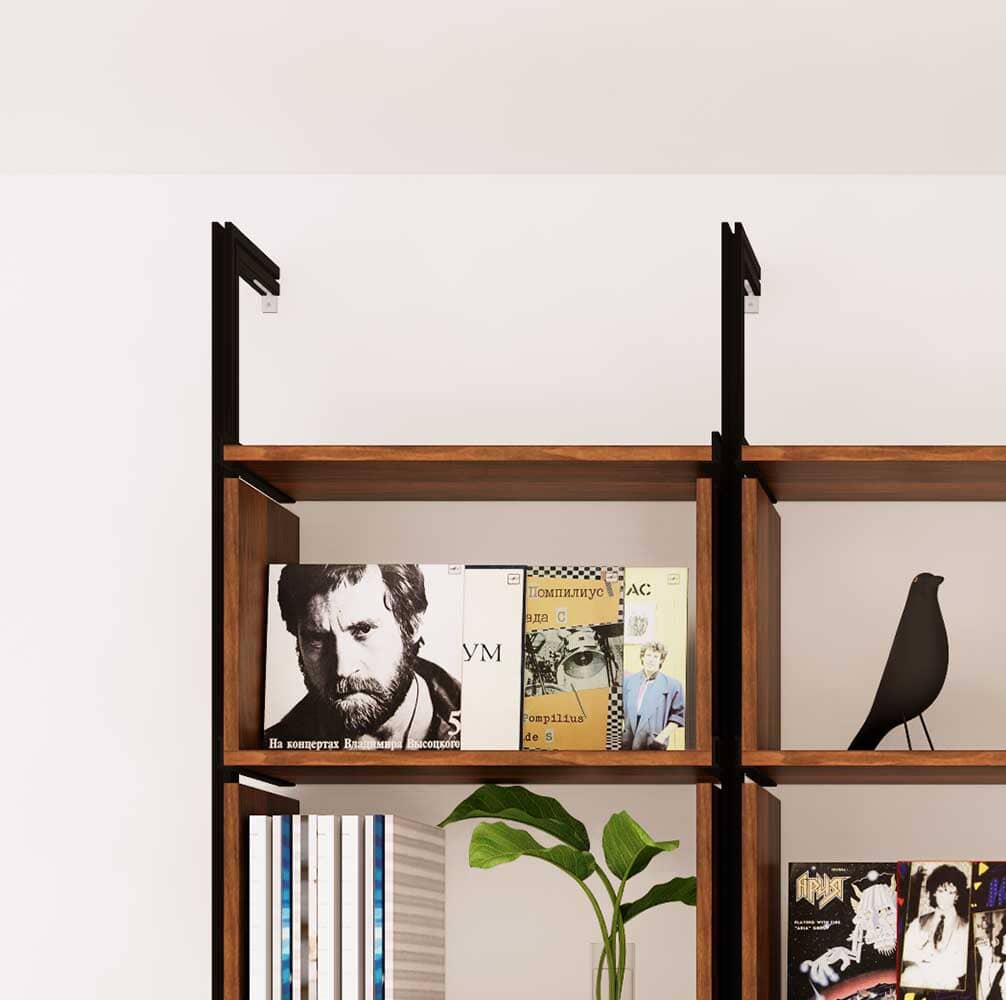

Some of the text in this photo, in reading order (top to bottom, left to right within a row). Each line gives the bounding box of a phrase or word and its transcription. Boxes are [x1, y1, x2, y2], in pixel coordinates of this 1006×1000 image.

[529, 586, 604, 600] Помпилиус
[626, 583, 651, 596] АС
[463, 643, 501, 662] УМ
[449, 711, 461, 736] 5
[269, 738, 460, 750] На концертах Владимира Высоцкого
